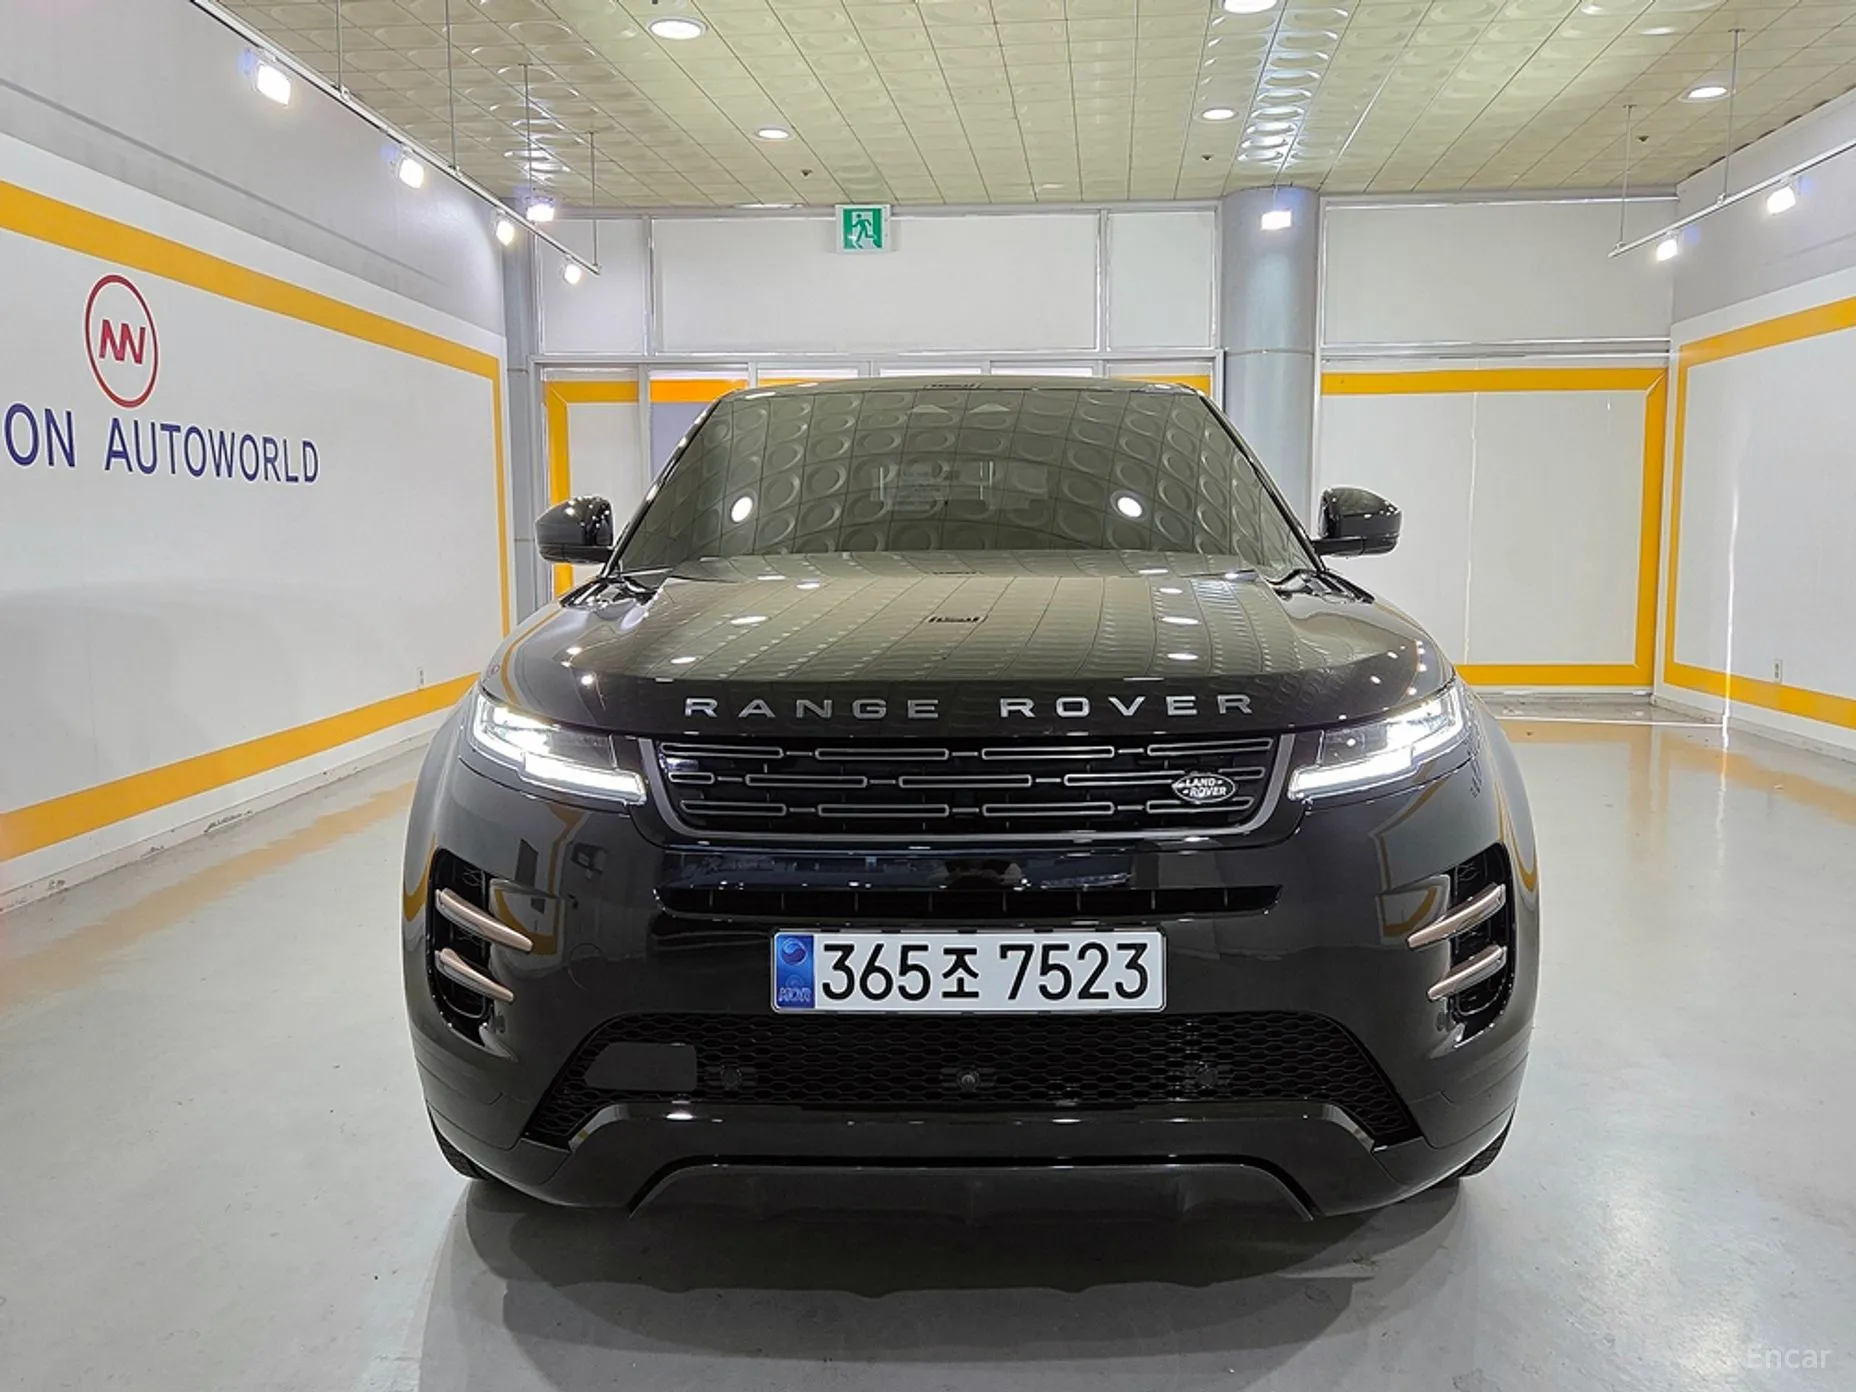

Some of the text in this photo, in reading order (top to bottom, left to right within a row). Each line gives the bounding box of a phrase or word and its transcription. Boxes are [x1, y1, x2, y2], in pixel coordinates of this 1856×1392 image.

[4, 403, 319, 483] ON AUTOWORLD
[684, 693, 1253, 720] RANGE ROVER
[1185, 778, 1217, 787] LAND
[1189, 786, 1227, 797] ROVER
[821, 942, 1149, 1001] 365조 7523
